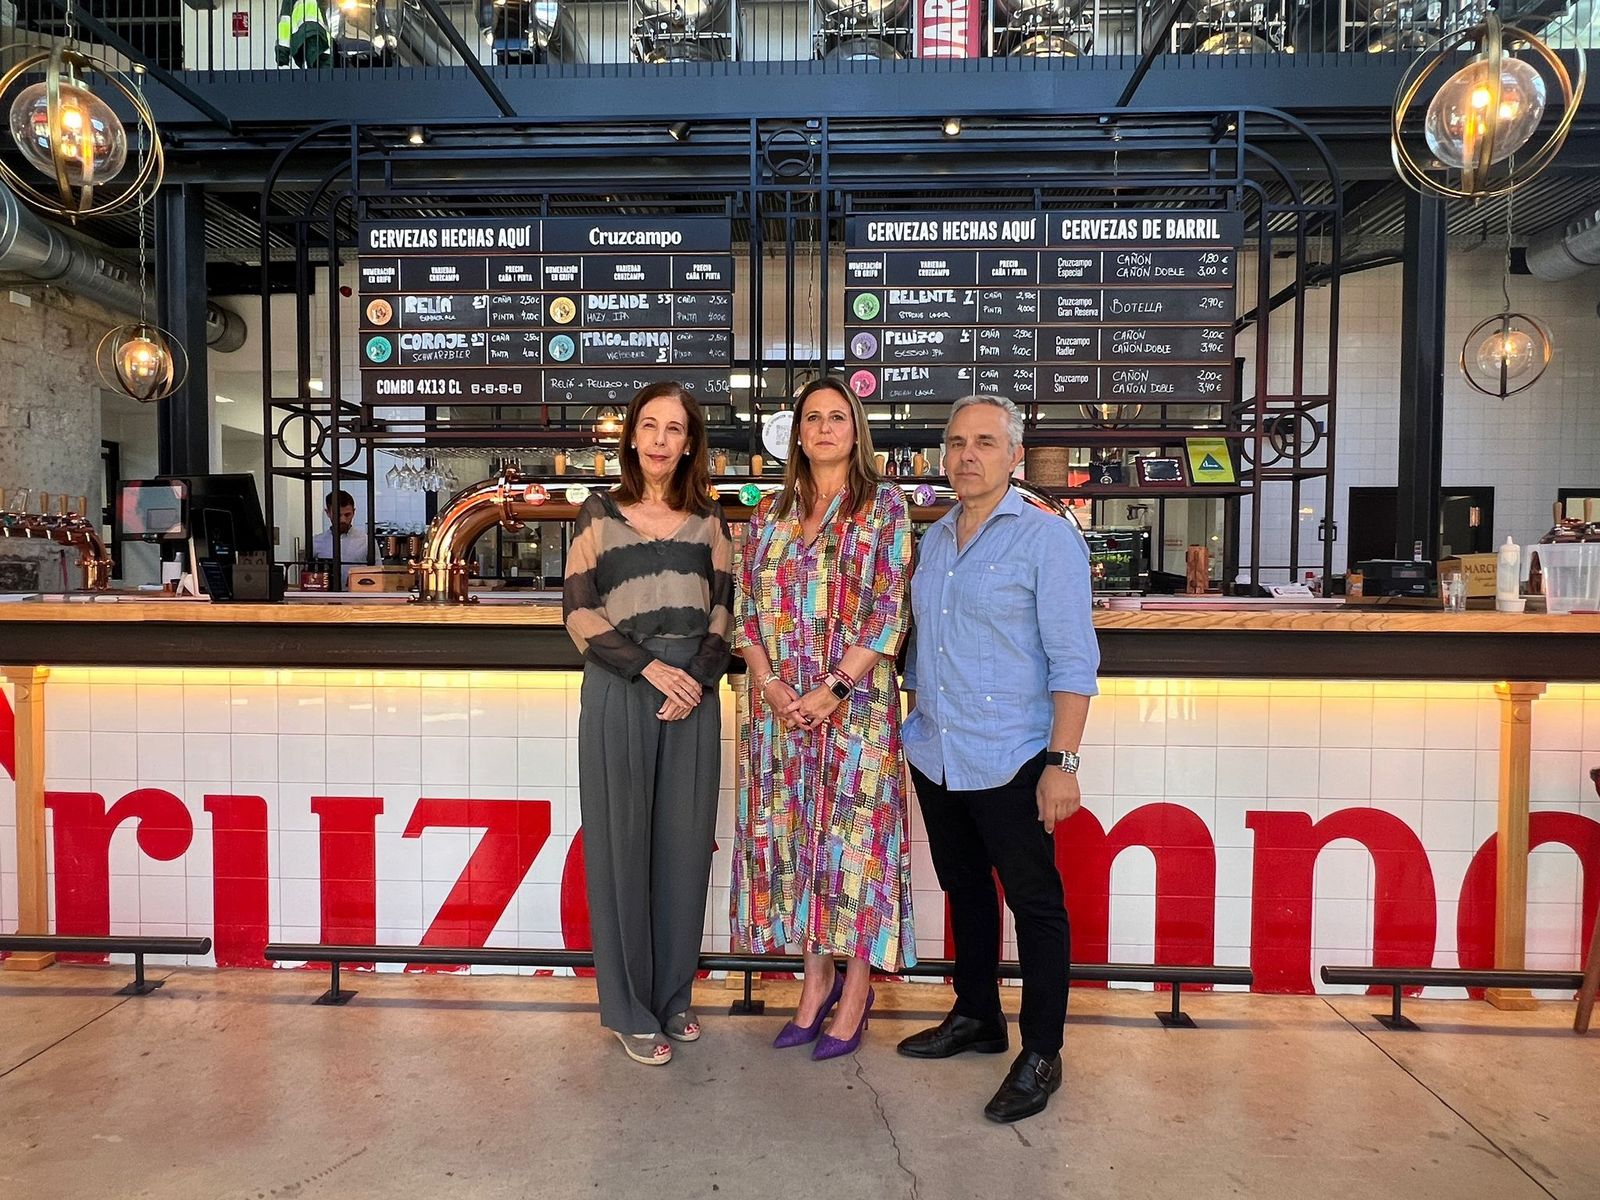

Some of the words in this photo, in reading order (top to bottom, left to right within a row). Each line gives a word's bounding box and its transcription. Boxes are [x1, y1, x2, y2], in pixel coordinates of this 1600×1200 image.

[868, 222, 938, 242] CERVEZAS
[942, 221, 998, 241] HECHAS
[1002, 218, 1037, 242] AQUÍ
[1062, 219, 1138, 240] CERVEZAS
[1143, 219, 1162, 239] DE
[1166, 219, 1221, 239] BARRIL
[371, 230, 437, 248] CERVEZAS
[442, 229, 494, 247] HECHAS
[498, 225, 532, 248] AQUÍ
[589, 227, 682, 248] Cruzcampo
[1058, 258, 1093, 268] Cruzcampo
[1116, 253, 1151, 265] CAÑÓN
[1058, 268, 1083, 277] Especial
[1116, 266, 1150, 278] CAÑÓN
[1154, 268, 1186, 277] DOBLE
[983, 292, 1002, 300] CAÑA
[1058, 297, 1093, 307] Cruzcampo
[588, 295, 650, 310] DUENDE
[1109, 299, 1163, 314] BOTELLA
[982, 306, 1002, 315] PINTA
[1058, 308, 1073, 317] Gran
[1075, 308, 1099, 317] Reserva
[492, 313, 515, 321] PINTA
[582, 332, 622, 347] TRIGO
[630, 332, 670, 347] RAMA
[885, 330, 944, 345] PELLIZCO
[1113, 328, 1147, 341] CAÑÓN
[401, 333, 469, 351] CORAJE
[1056, 336, 1090, 346] Cruzcampo
[980, 346, 1000, 357] PINTA
[1056, 347, 1076, 356] Radler
[1112, 341, 1143, 354] CAÑÓN
[1144, 344, 1172, 354] DOBLE
[981, 370, 999, 379] CAÑA
[1054, 374, 1089, 384] Cruzcampo
[1112, 369, 1149, 382] CAÑÓN
[377, 380, 414, 395] COMBO
[417, 379, 446, 395] 4X13
[979, 382, 999, 392] PINTA
[1054, 384, 1065, 393] Sin
[1112, 382, 1147, 394] CAÑÓN
[1151, 384, 1175, 393] DOBLE
